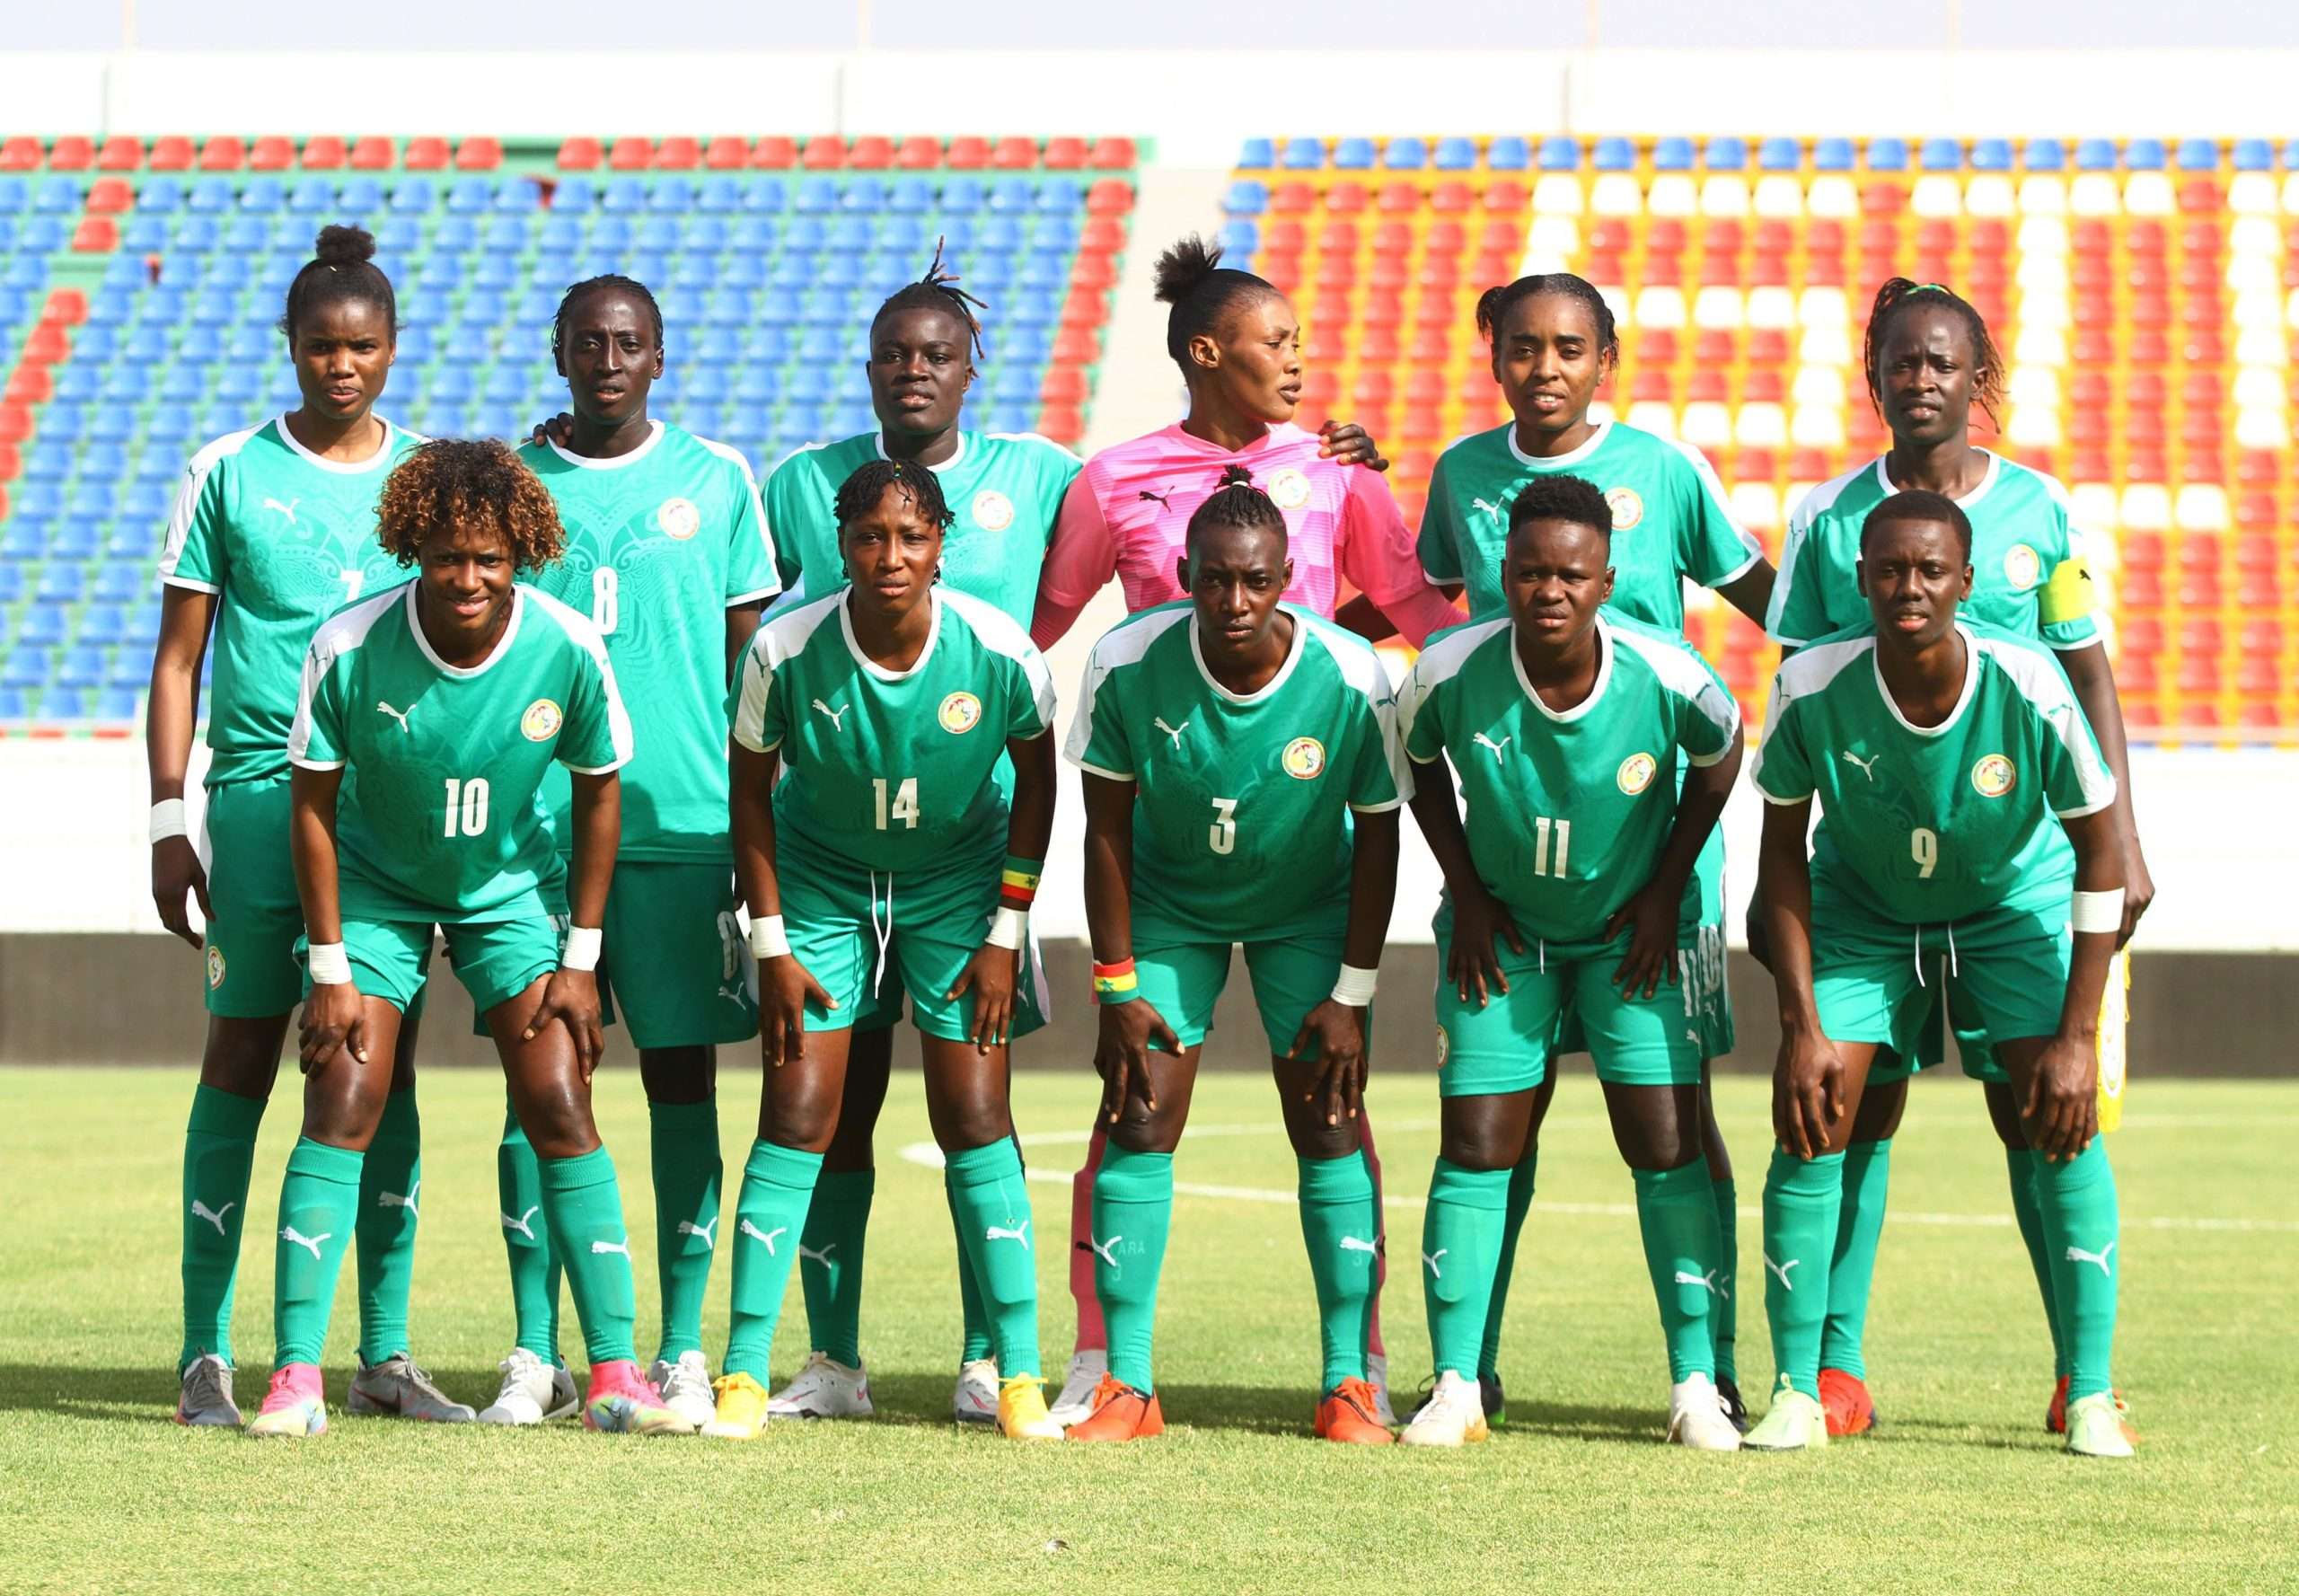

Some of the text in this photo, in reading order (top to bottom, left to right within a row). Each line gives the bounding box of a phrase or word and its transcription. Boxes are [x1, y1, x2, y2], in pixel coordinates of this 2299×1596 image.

[340, 569, 364, 603] 7
[593, 566, 618, 635] 8
[444, 778, 489, 838] 10
[873, 778, 920, 830] 14
[1209, 798, 1238, 855] 3
[1535, 816, 1570, 878] 11
[1912, 828, 1937, 877] 9
[717, 911, 738, 981] 8
